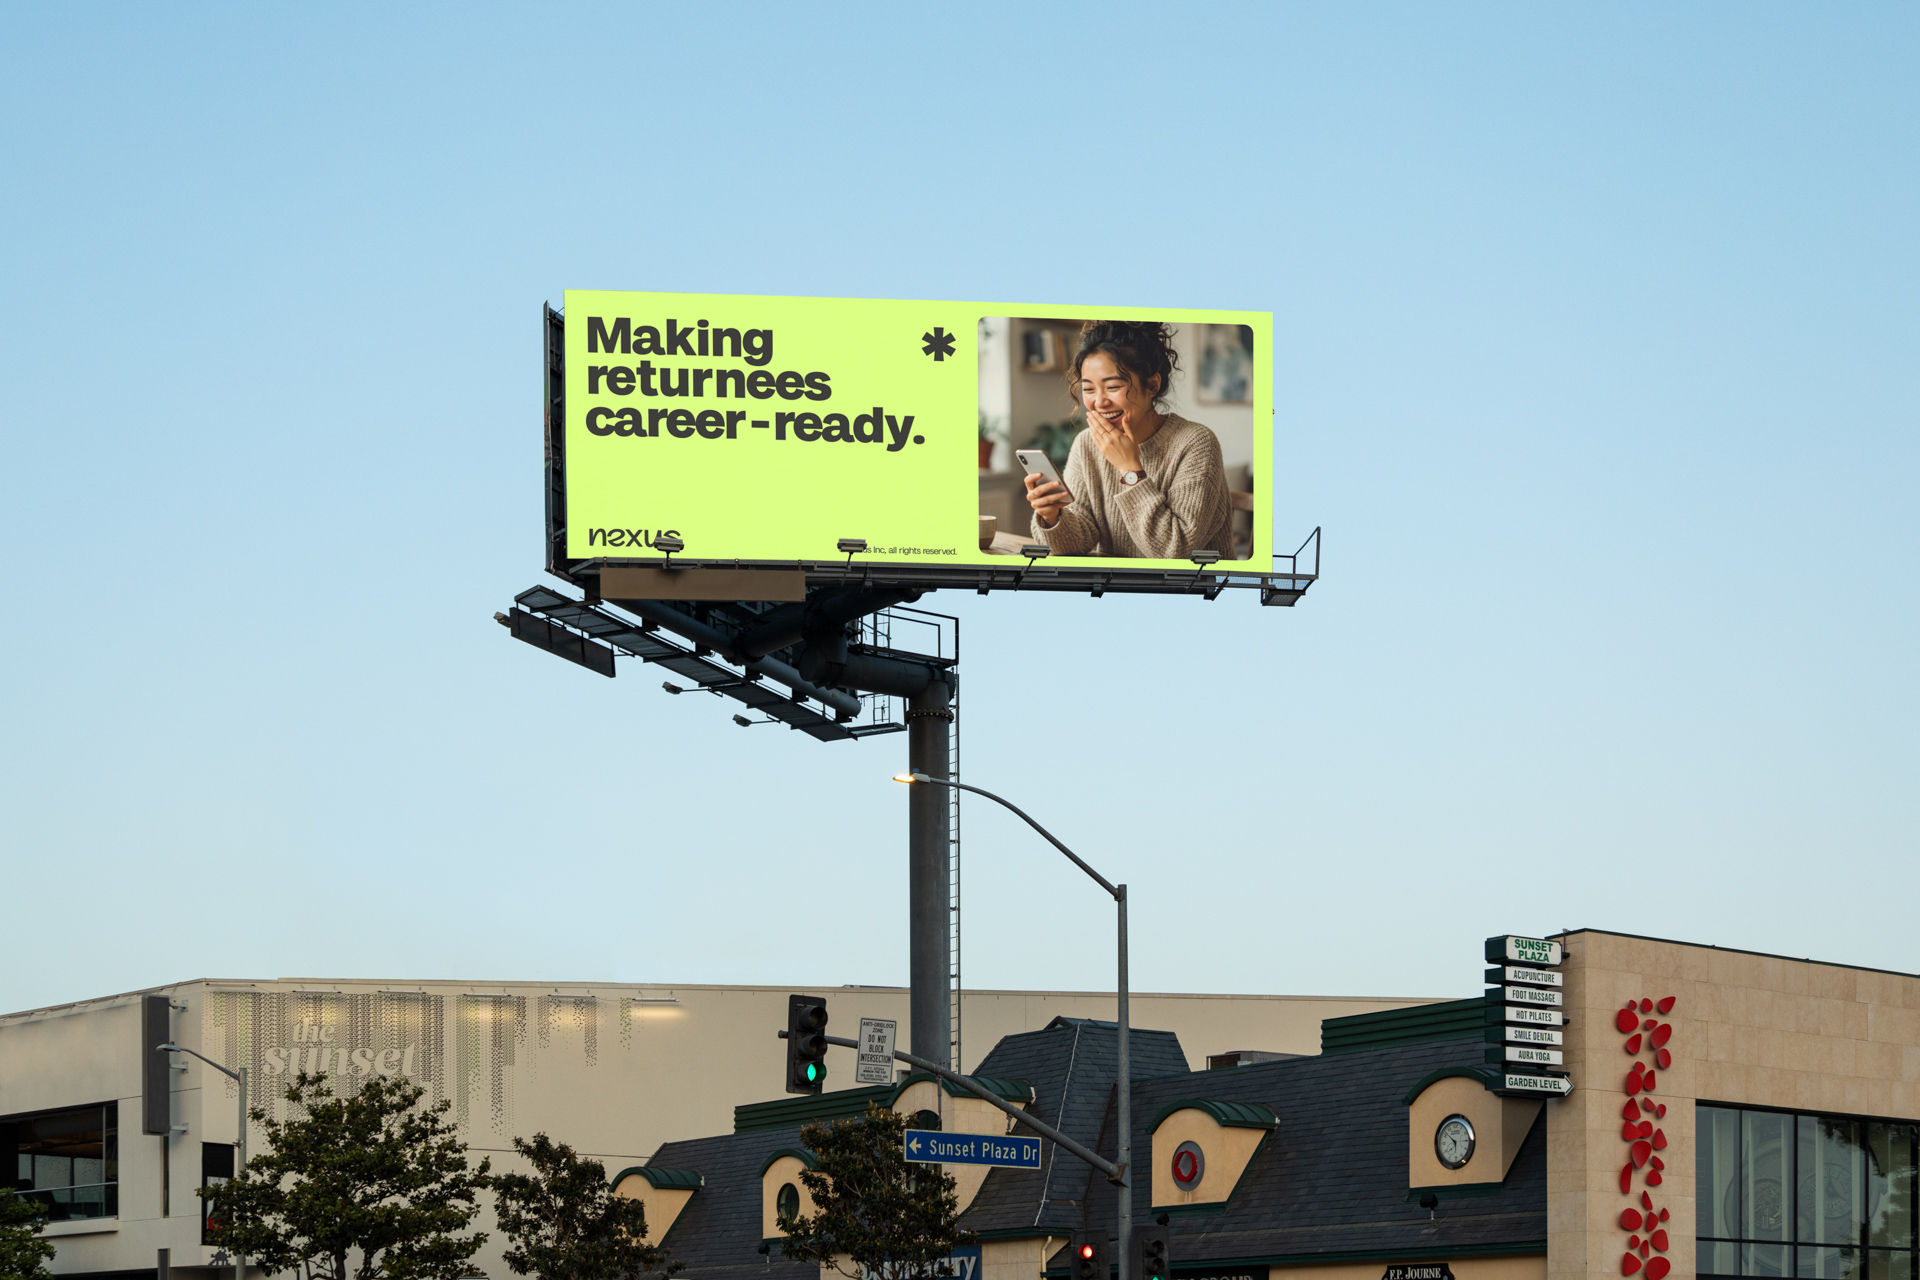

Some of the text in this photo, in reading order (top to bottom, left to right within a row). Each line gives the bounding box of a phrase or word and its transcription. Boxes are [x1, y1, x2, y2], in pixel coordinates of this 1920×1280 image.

[588, 317, 774, 366] Making
[588, 360, 832, 402] returnees
[586, 407, 925, 453] career-ready.
[888, 546, 898, 554] all
[899, 547, 921, 556] rights
[922, 548, 957, 556] reserved.
[1514, 939, 1553, 952] SUNSET
[1518, 950, 1550, 962] PLAZA
[1513, 970, 1555, 983] ACUPUNCTURE
[1512, 989, 1556, 1003] FOOT MASSAGE
[1516, 1010, 1552, 1022] HOT PILATES
[292, 1017, 335, 1043] the
[863, 1021, 895, 1029] ANTI-GRIDLOCK
[868, 1034, 887, 1044] DO NOT
[1514, 1029, 1554, 1042] SMILE DENTAL
[868, 1044, 884, 1053] BLOCK
[262, 1042, 421, 1077] sunset
[860, 1054, 891, 1063] INTERSECTION
[1518, 1050, 1551, 1062] AURA YOGA
[1508, 1077, 1562, 1090] GARDEN LEVEL
[929, 1139, 1038, 1161] Sunset Plaza Dr
